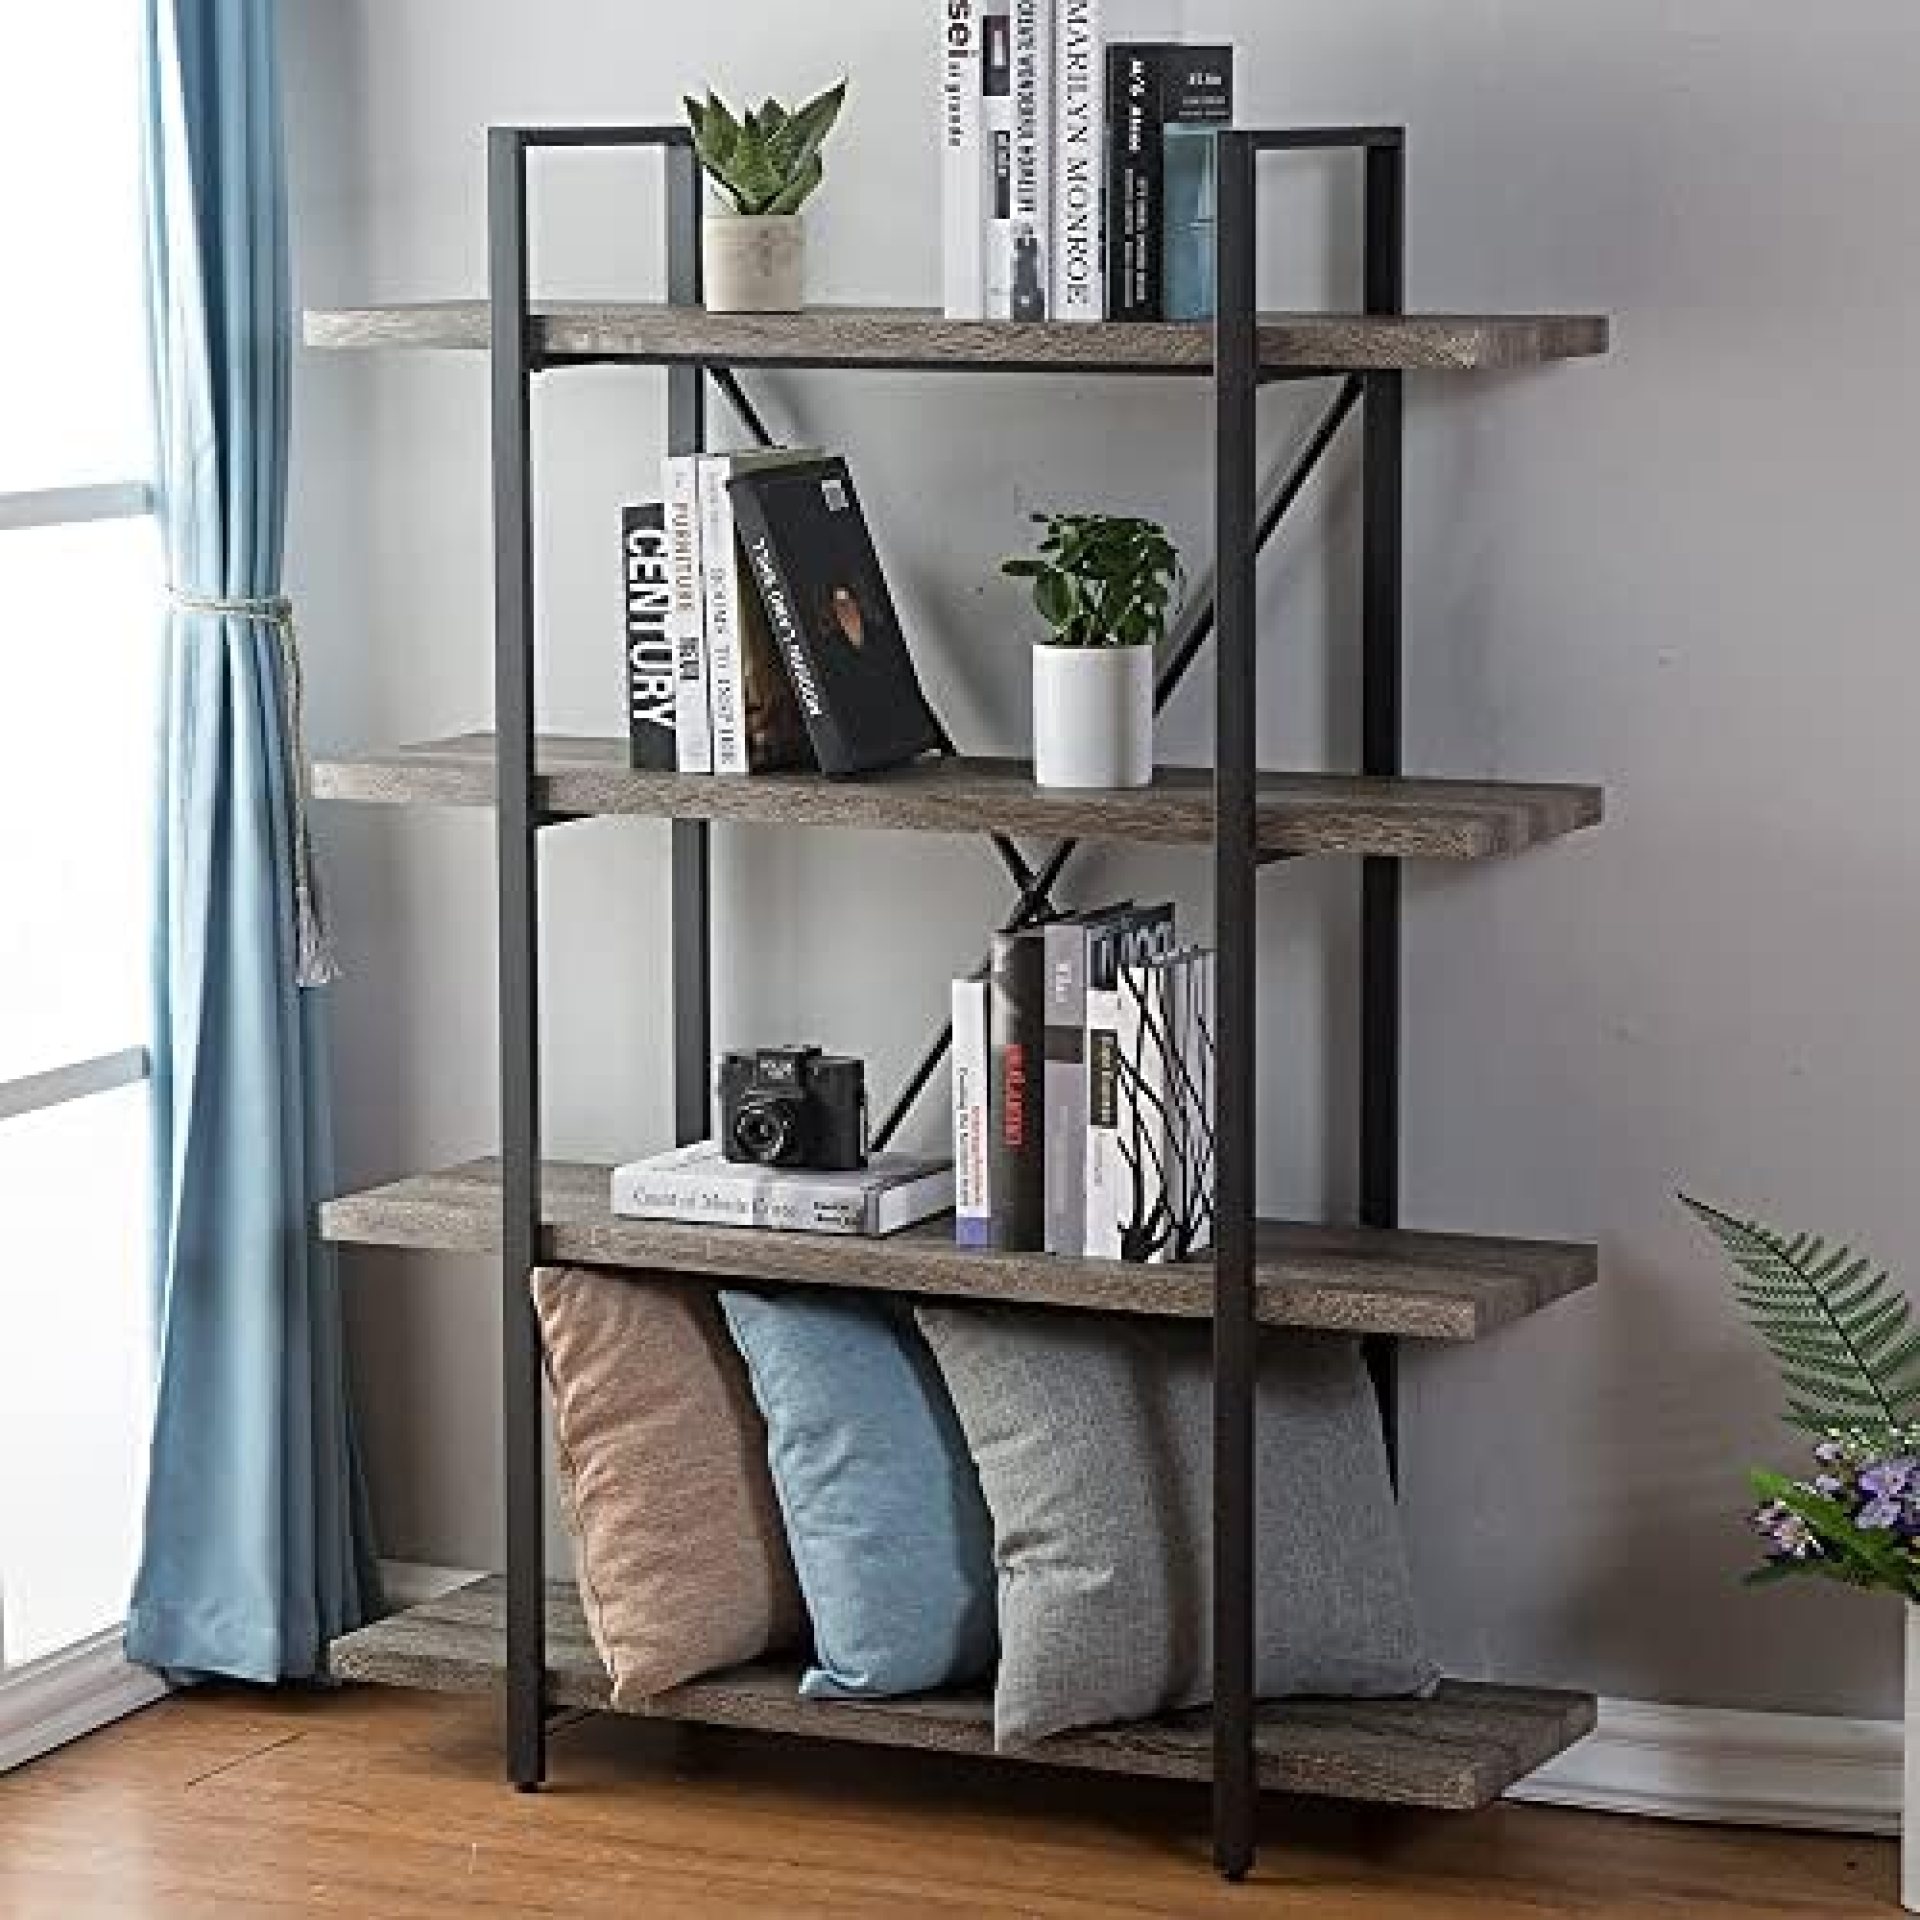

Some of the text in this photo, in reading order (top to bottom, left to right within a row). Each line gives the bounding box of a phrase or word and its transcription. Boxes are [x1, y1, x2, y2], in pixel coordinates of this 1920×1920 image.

[1066, 0, 1089, 306] MARILYN MONROE
[628, 528, 676, 729] CENTURY
[672, 502, 694, 613] FURNITURE
